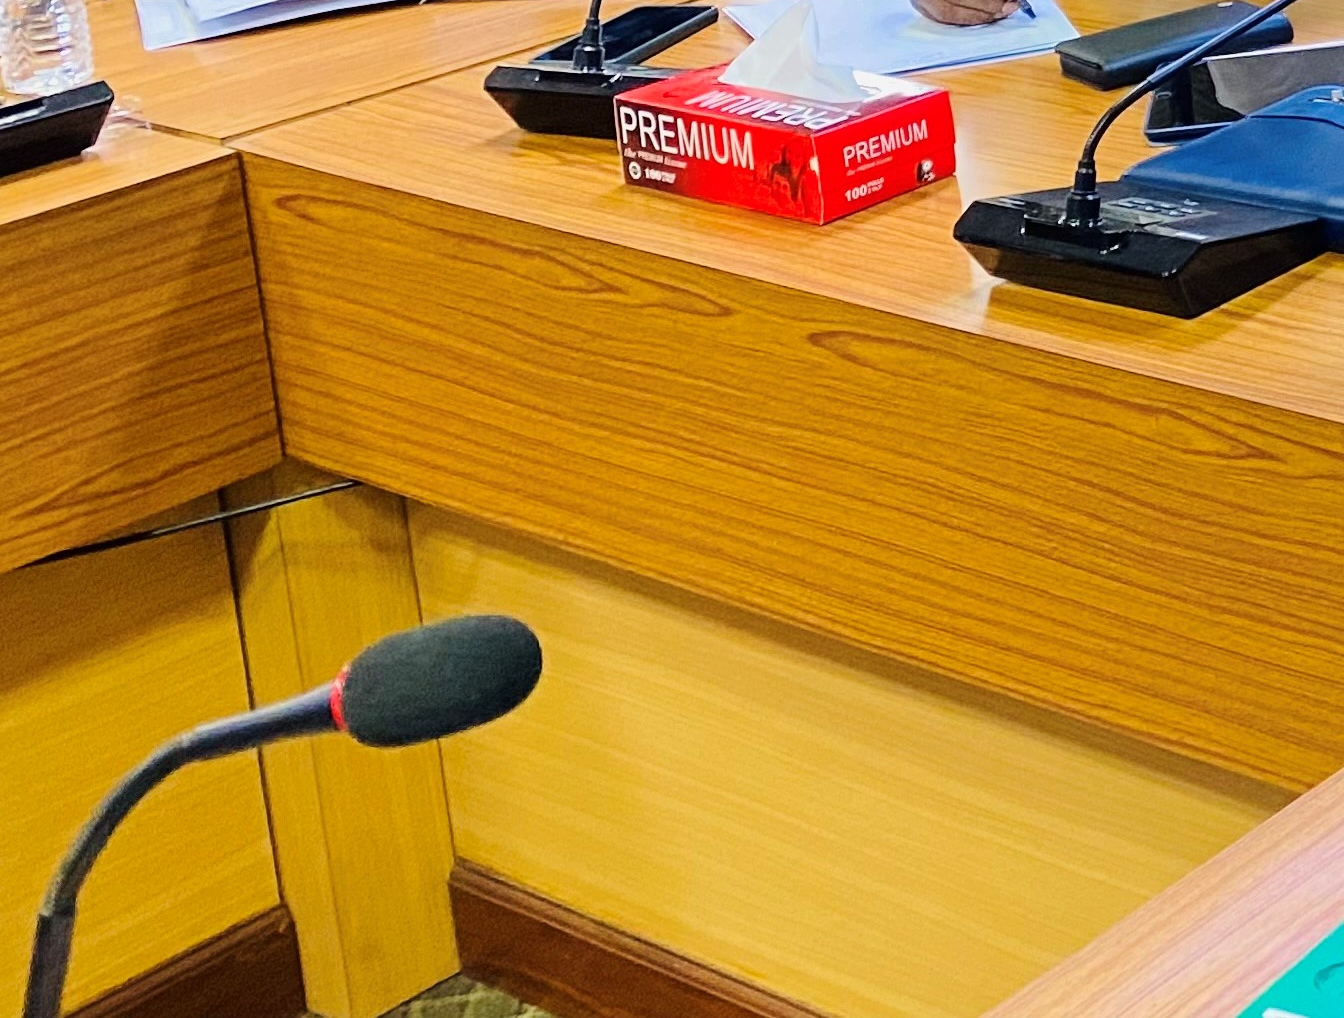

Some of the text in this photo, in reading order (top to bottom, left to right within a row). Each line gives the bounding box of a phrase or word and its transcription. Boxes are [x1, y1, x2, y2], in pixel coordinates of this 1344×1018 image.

[685, 89, 851, 131] PREMIUM
[619, 105, 754, 171] PREMIUM
[842, 118, 929, 169] PREMIUM
[845, 184, 868, 201] 100
